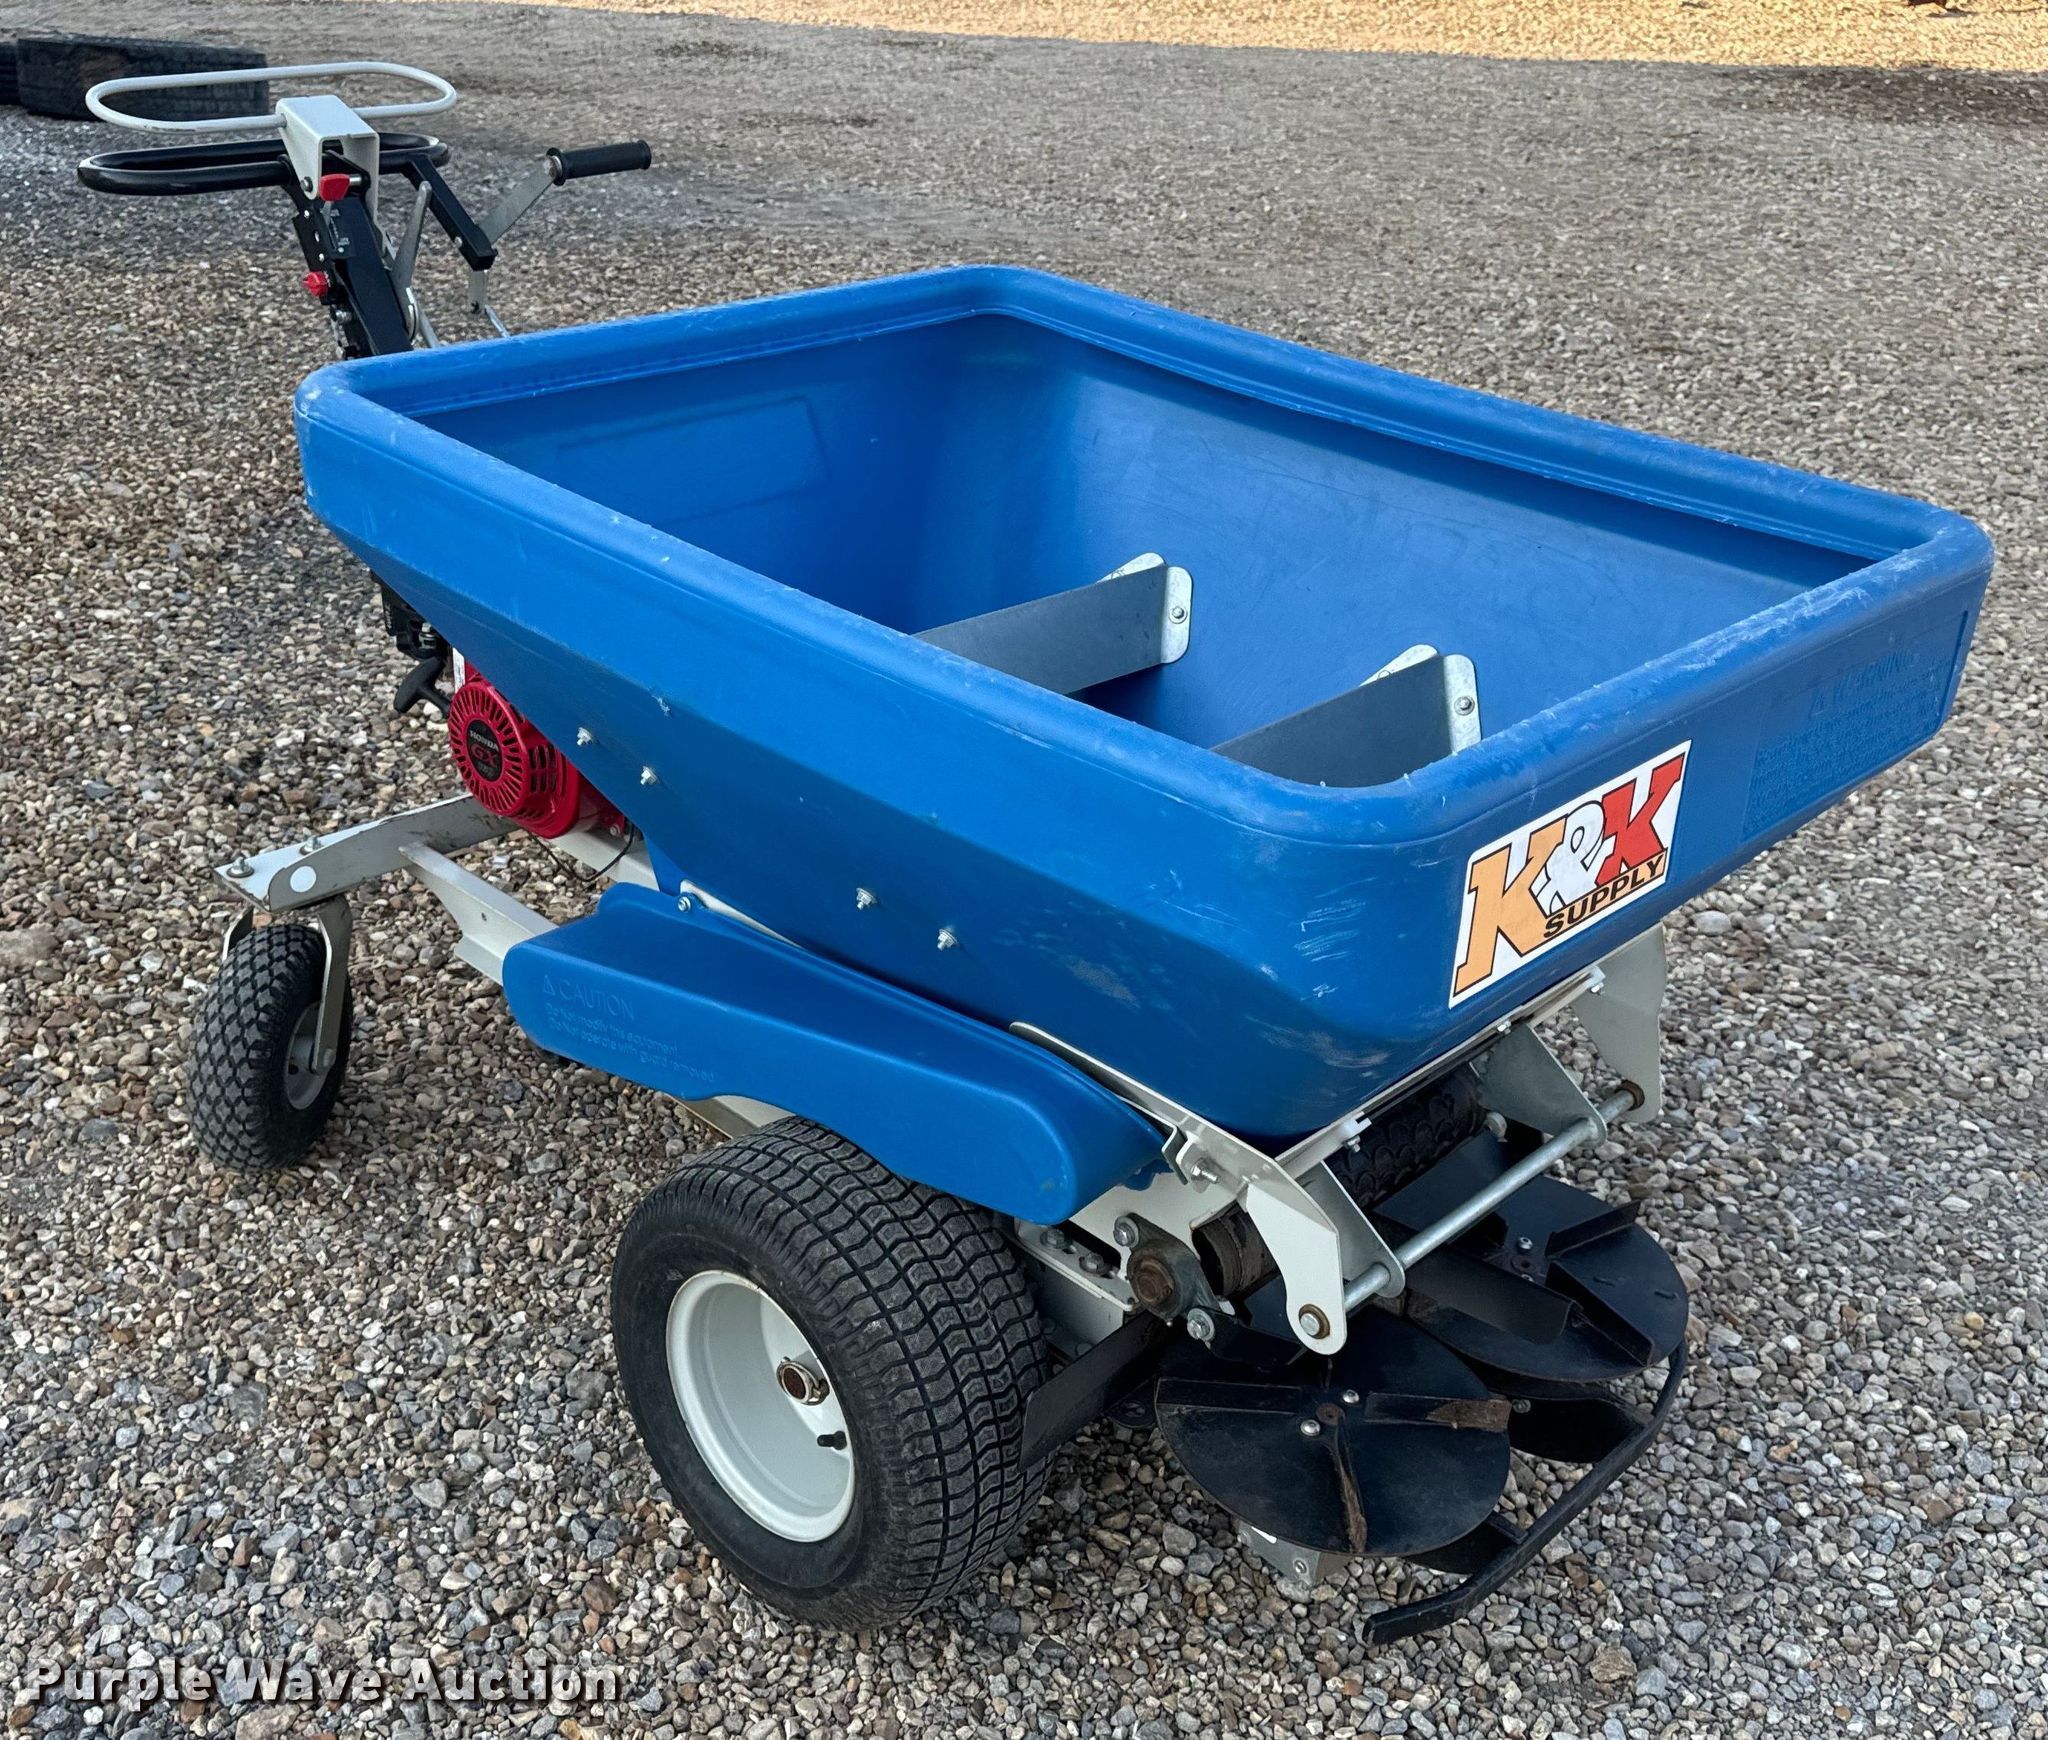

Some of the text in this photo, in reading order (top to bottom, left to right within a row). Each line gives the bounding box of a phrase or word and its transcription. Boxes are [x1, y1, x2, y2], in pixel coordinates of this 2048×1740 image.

[470, 730, 499, 751] HONDA
[470, 742, 499, 768] GX
[1543, 854, 1665, 938] SUPPLY
[559, 979, 635, 1021] CAUTION
